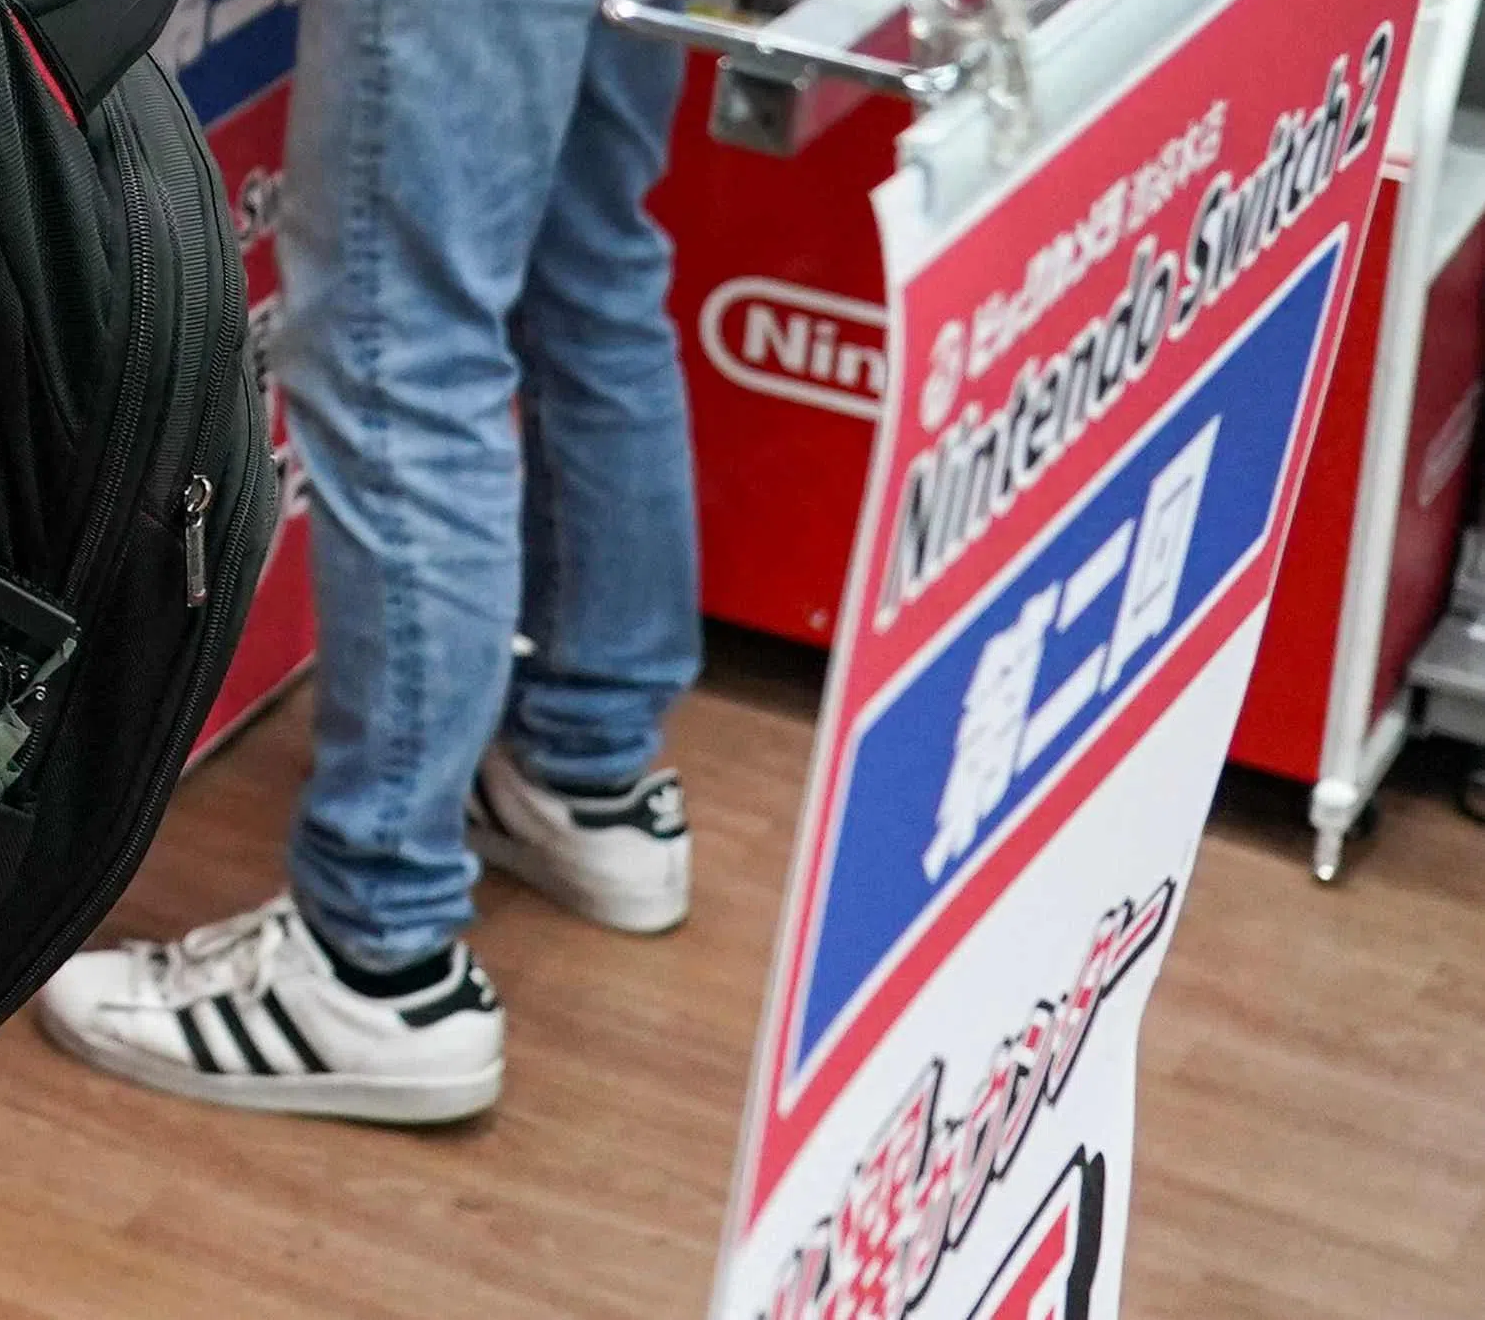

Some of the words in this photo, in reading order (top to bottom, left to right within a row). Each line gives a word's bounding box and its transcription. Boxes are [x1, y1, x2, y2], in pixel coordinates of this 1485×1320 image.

[873, 235, 1178, 631] Nintendo
[1169, 54, 1352, 341] Switch
[1339, 19, 1396, 170] 2
[921, 413, 1223, 884] 第二回
